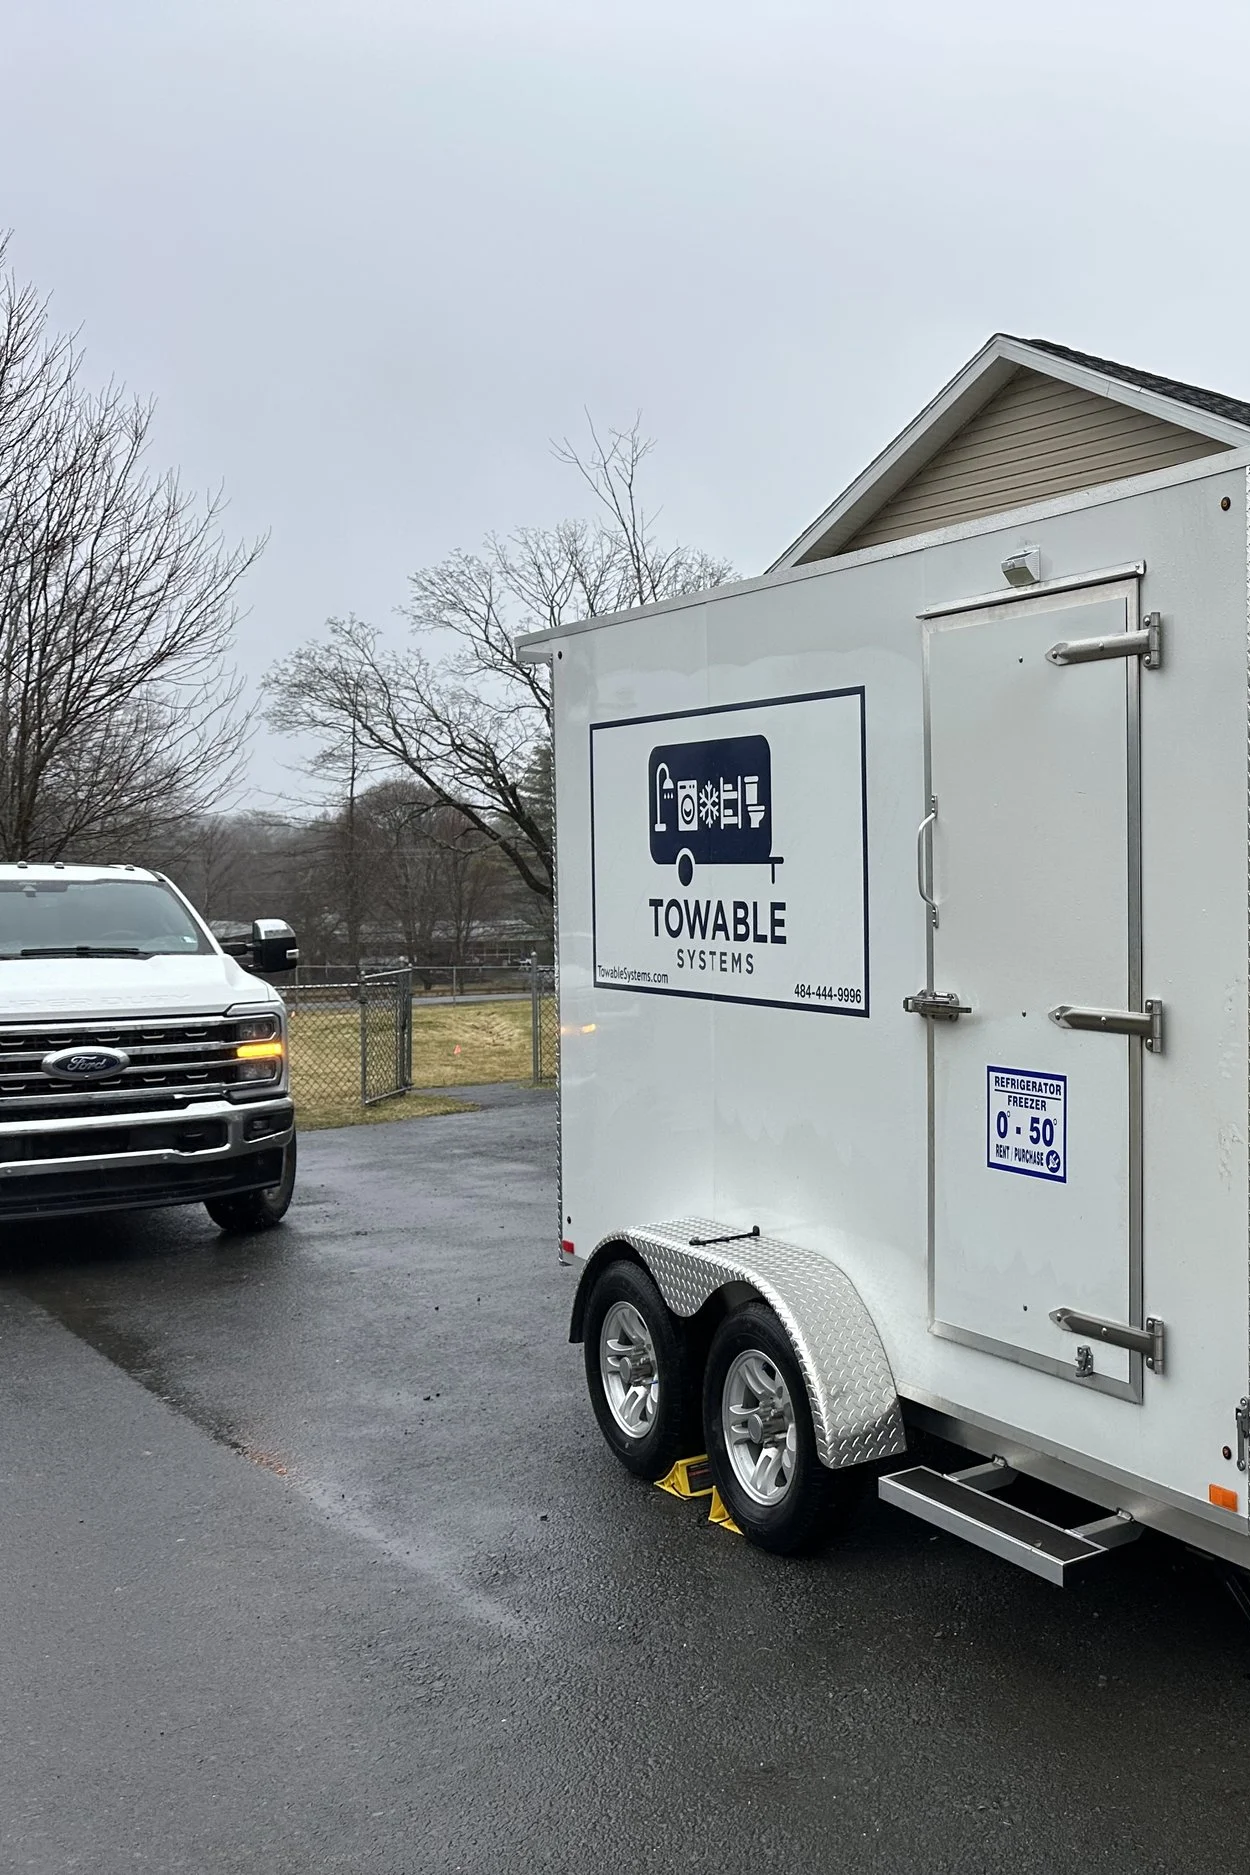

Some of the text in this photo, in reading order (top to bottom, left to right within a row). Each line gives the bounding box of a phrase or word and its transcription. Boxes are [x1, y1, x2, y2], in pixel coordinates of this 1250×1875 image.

[648, 898, 787, 945] TOWABLE
[676, 948, 755, 975] SYSTEMS
[597, 964, 669, 985] TowableSystems.com
[794, 982, 862, 1005] 484-444-9996
[66, 1055, 108, 1071] Ford
[994, 1076, 1062, 1096] REFRIGERATOR
[1007, 1095, 1047, 1112] FREEZER
[995, 1143, 1010, 1160] RENT
[1014, 1146, 1044, 1167] PURCHASE
